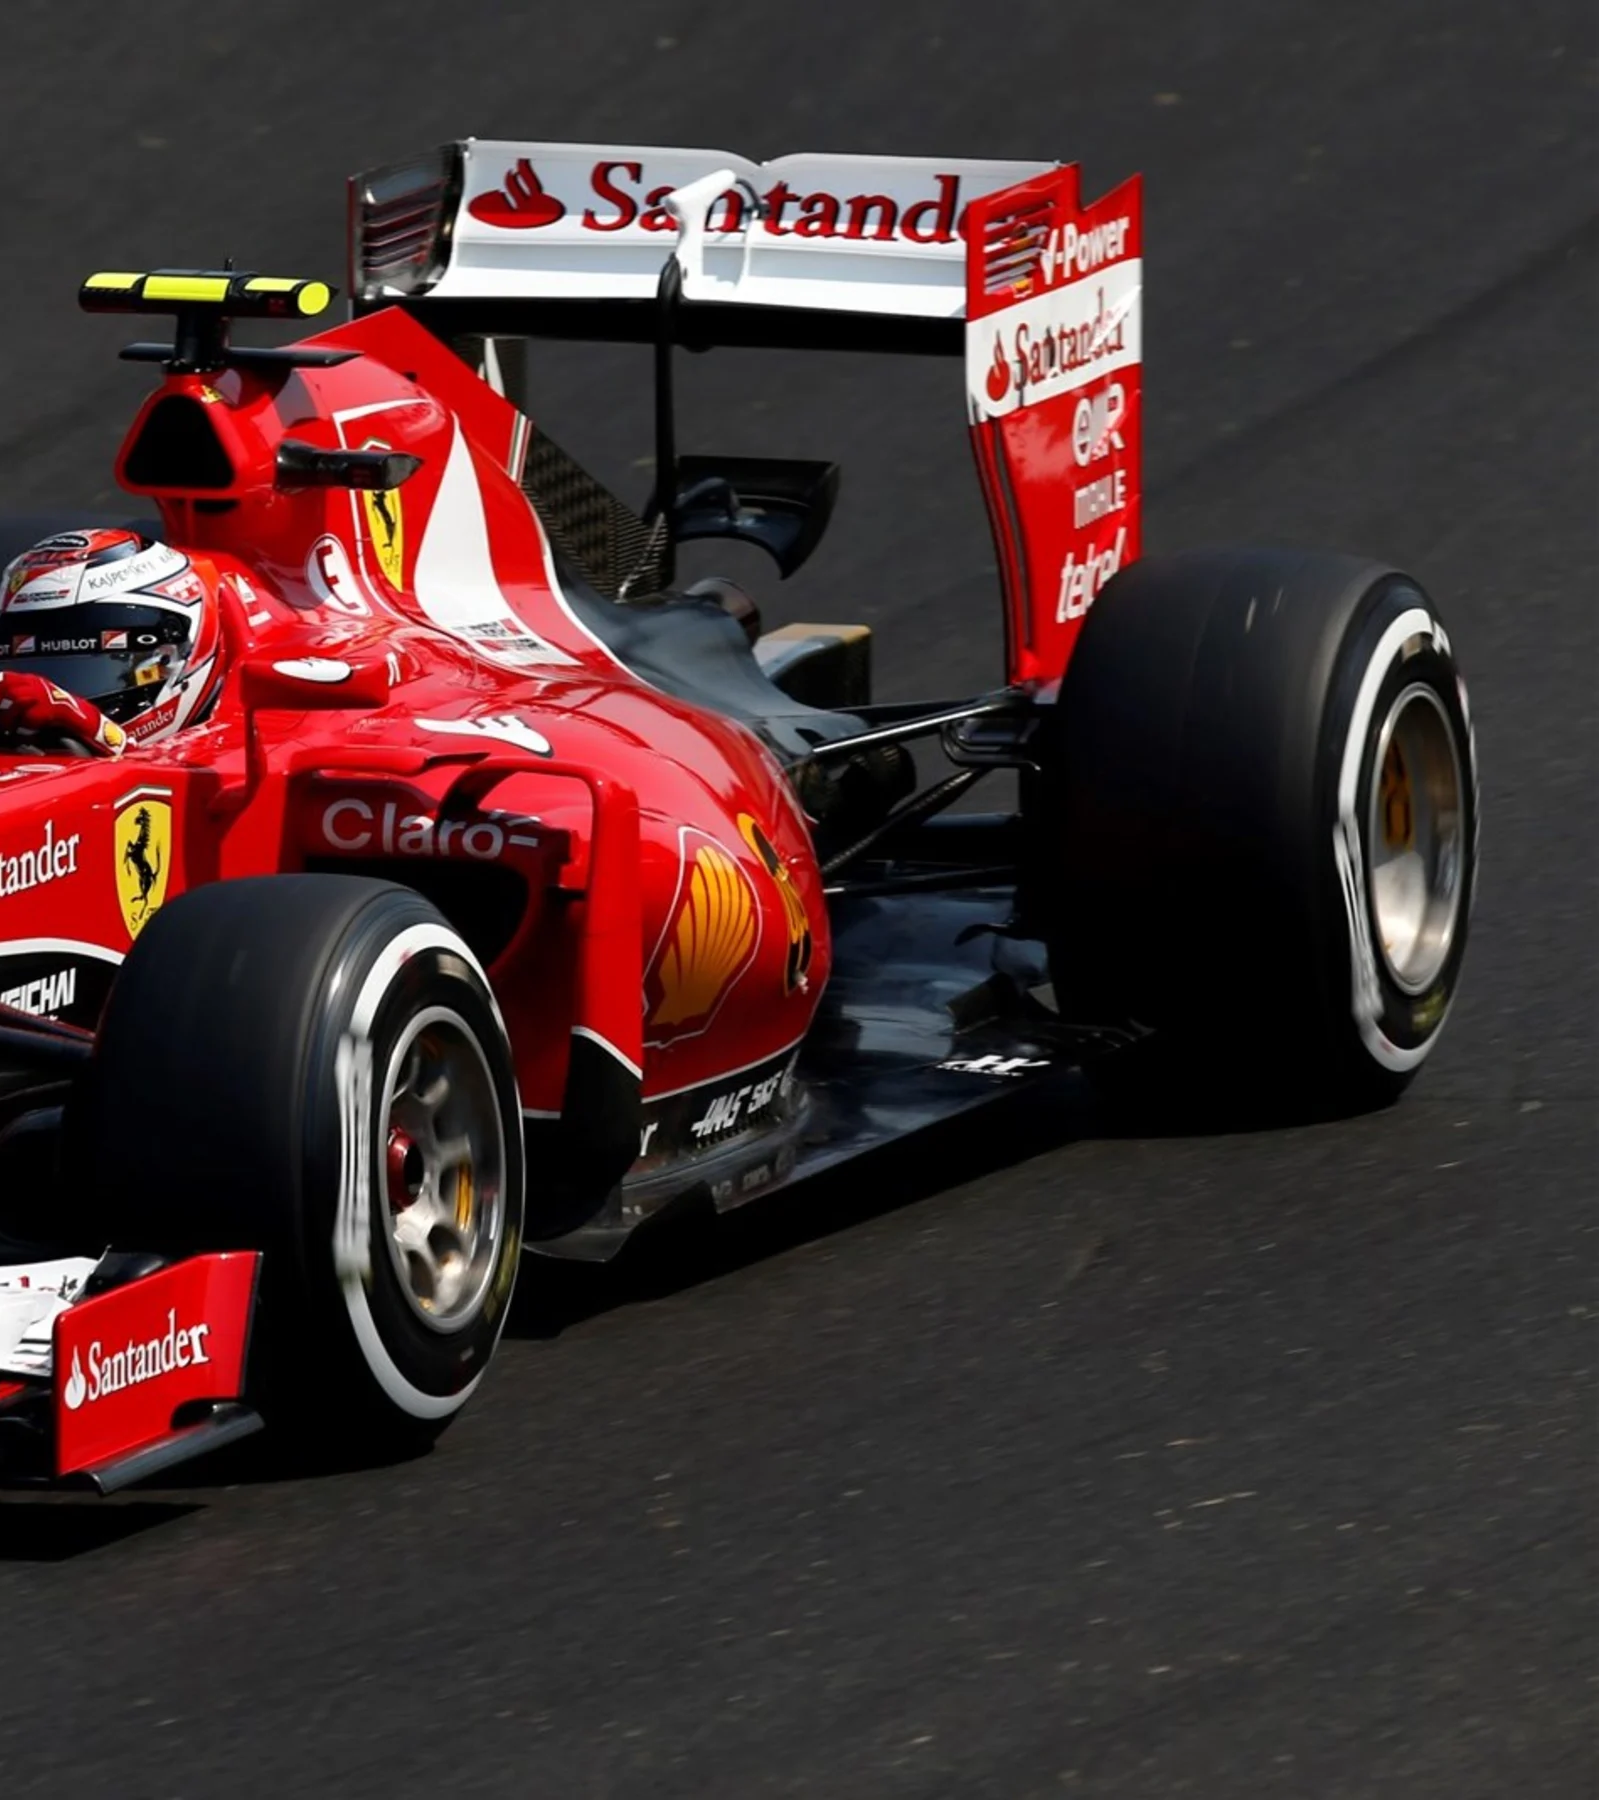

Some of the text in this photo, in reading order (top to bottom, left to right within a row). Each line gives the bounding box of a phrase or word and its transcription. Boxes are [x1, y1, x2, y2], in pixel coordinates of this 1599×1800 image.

[580, 159, 974, 244] Santand
[41, 639, 98, 651] HUBLOT
[322, 798, 504, 859] Claro
[87, 1309, 209, 1400] Santander
